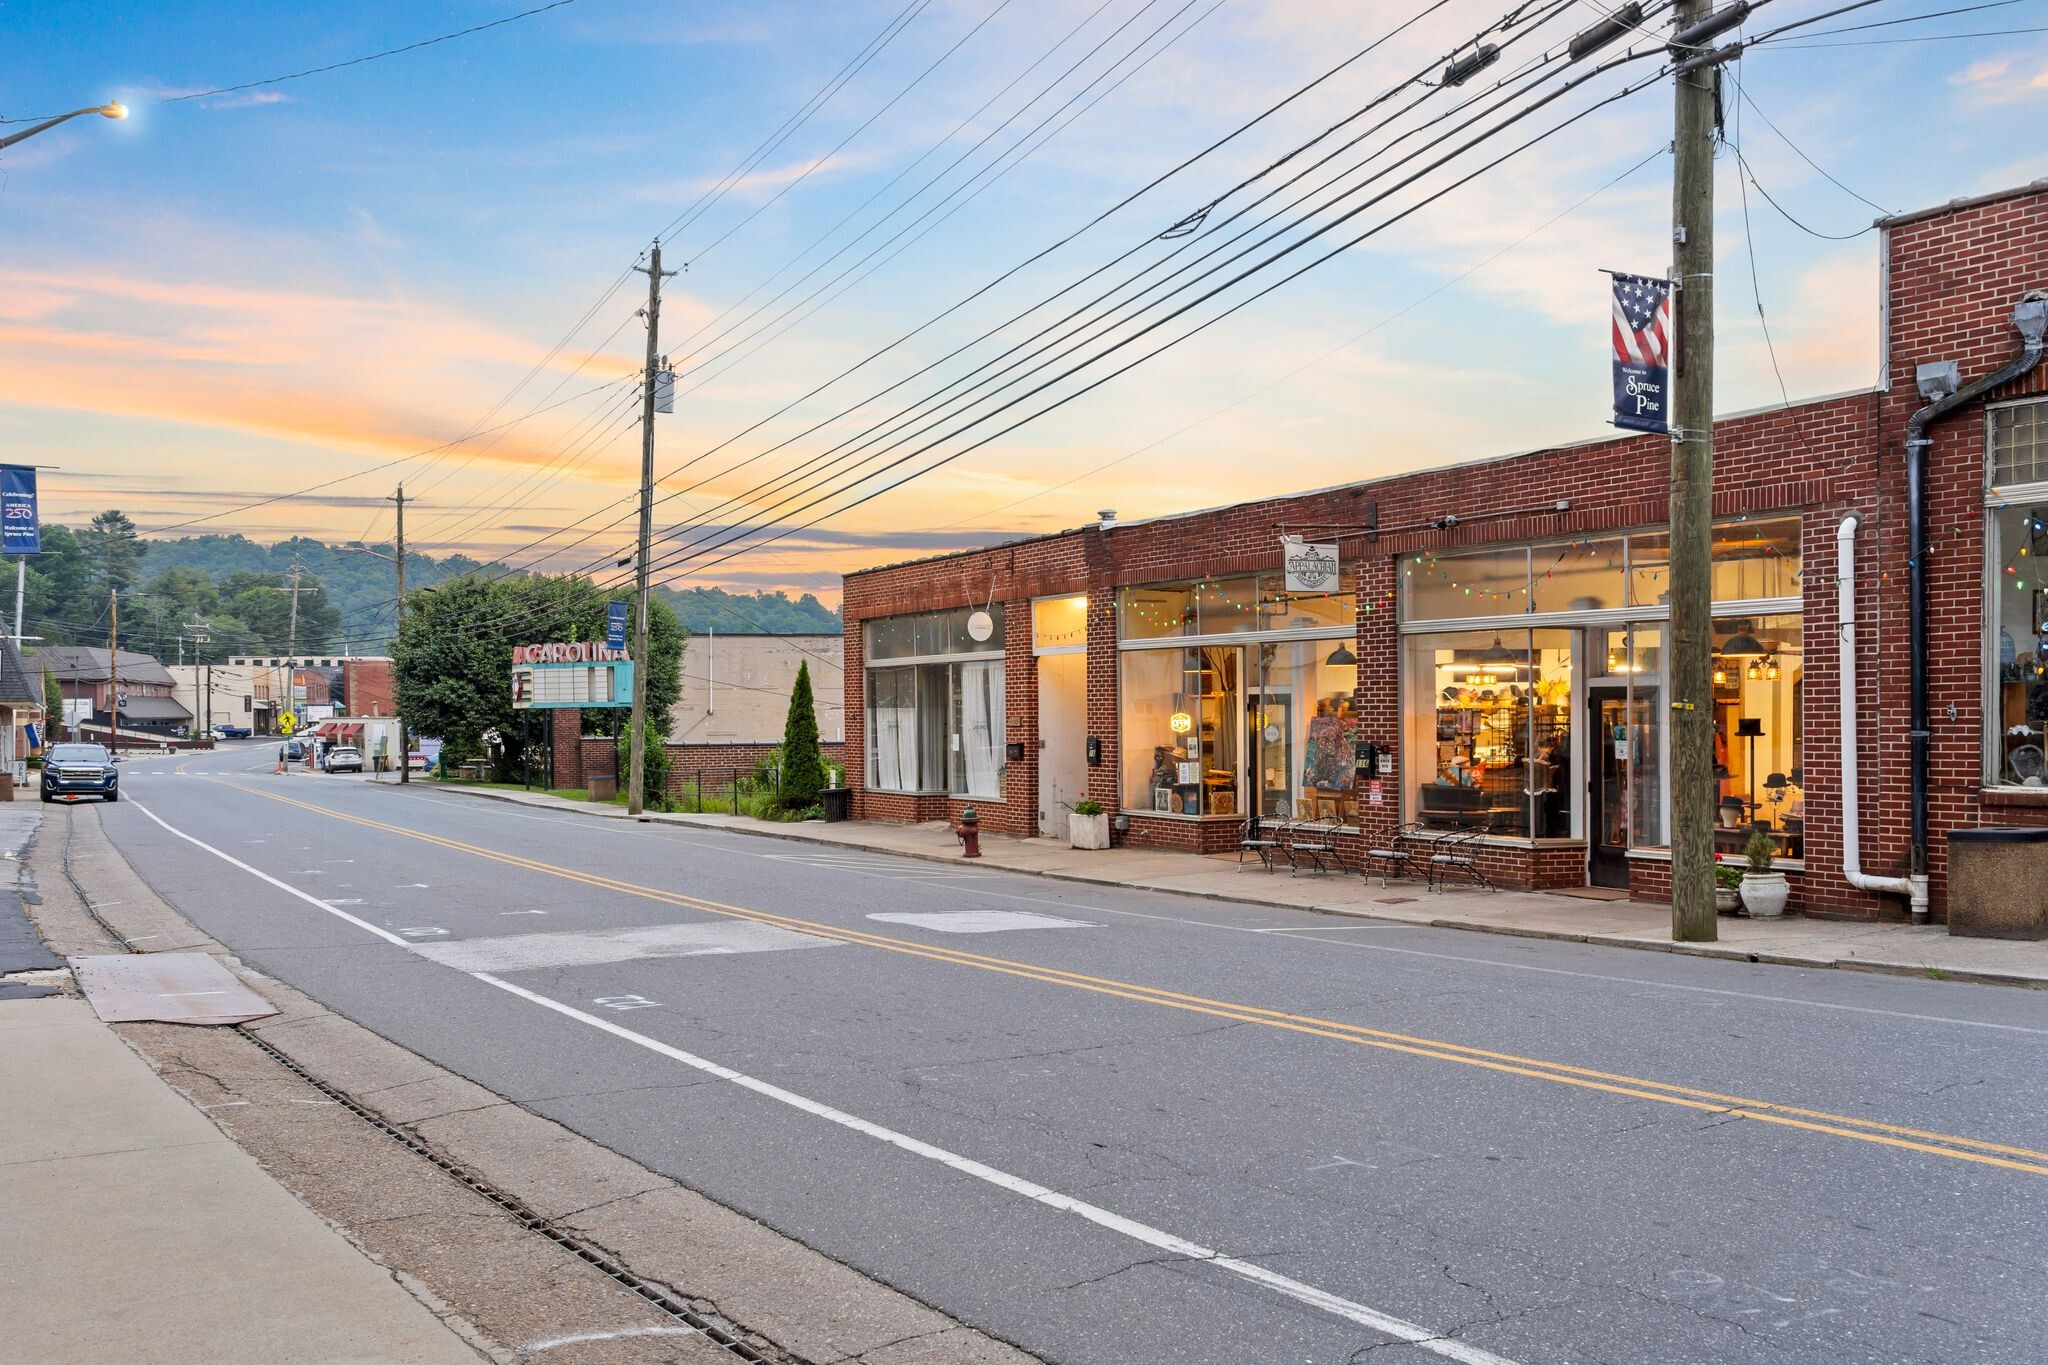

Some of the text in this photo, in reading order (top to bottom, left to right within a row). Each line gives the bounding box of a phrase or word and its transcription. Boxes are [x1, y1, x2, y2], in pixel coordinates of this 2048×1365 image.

[1622, 367, 1641, 375] Welcome
[1625, 375, 1660, 396] Spruce
[1635, 394, 1659, 415] Pine
[6, 508, 32, 519] 250
[525, 641, 628, 663] CAROLINA
